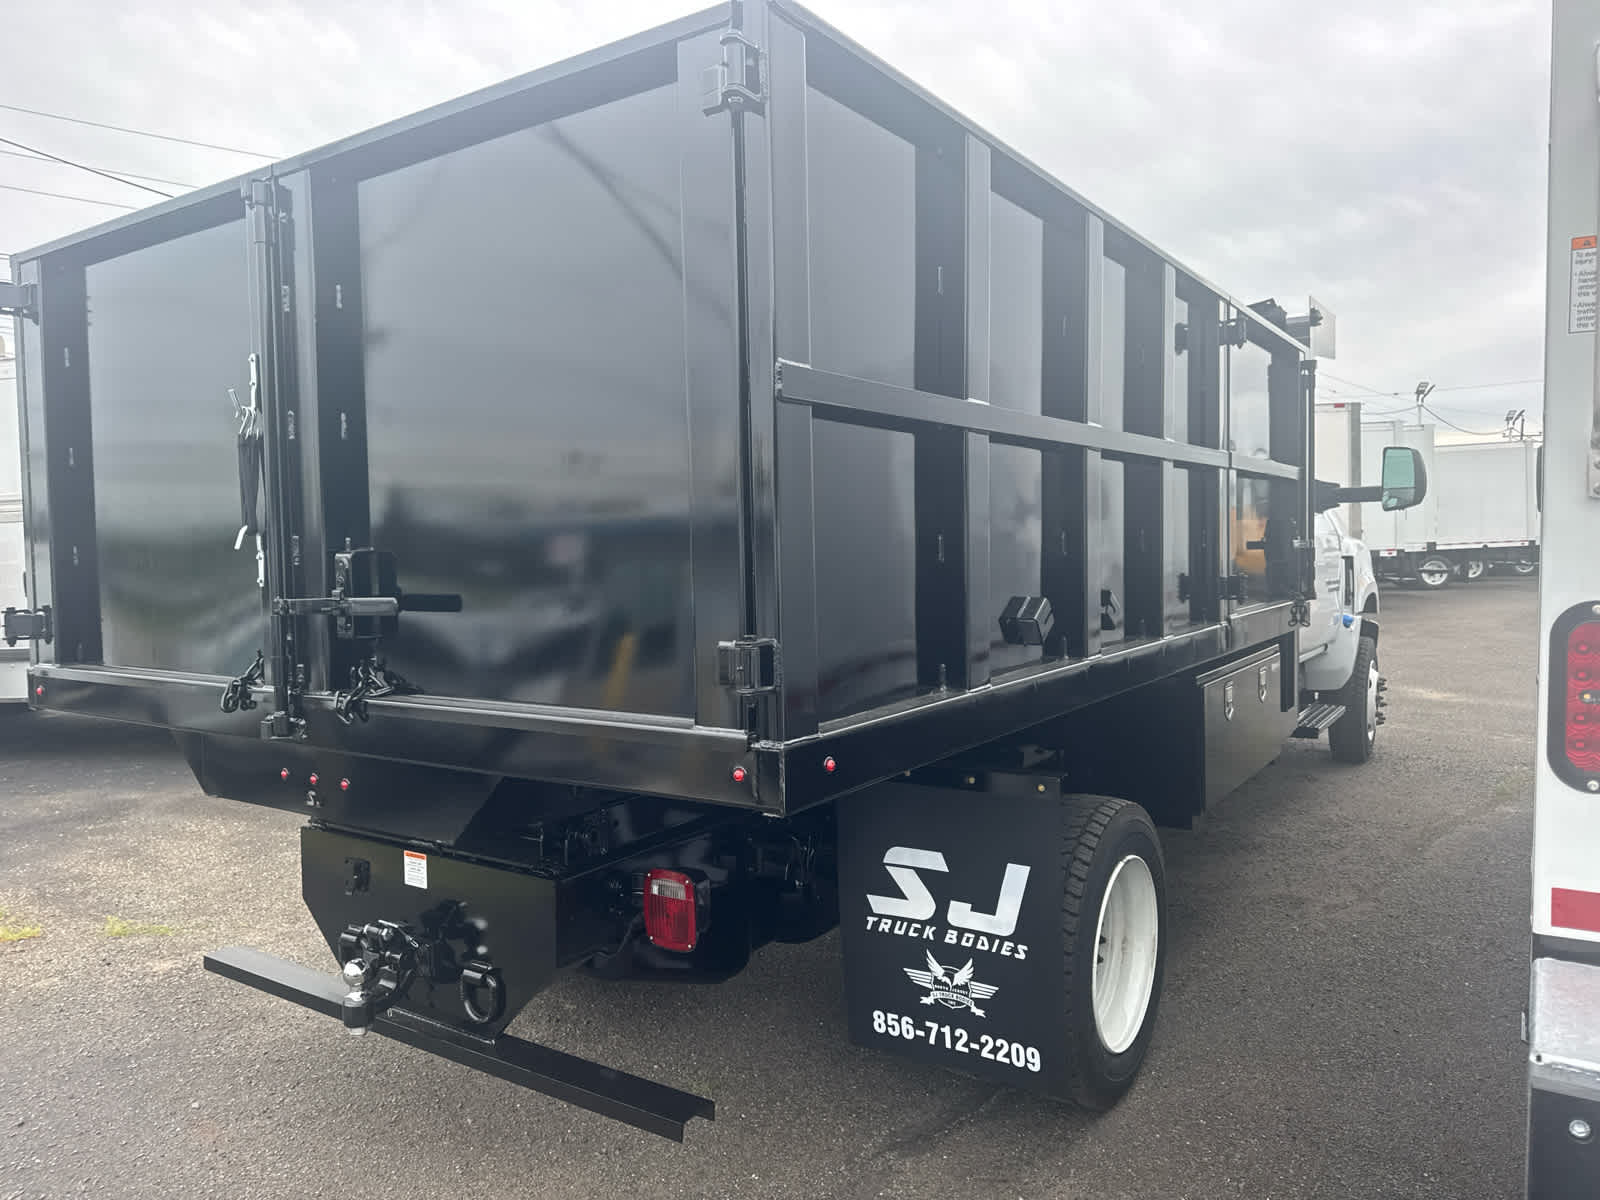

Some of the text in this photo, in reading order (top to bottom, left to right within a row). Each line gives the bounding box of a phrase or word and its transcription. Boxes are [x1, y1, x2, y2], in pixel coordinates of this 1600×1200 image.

[866, 846, 1031, 937] SJ
[866, 916, 1029, 960] TRUCK BODIES
[872, 1010, 1041, 1072] 856-712-2209
